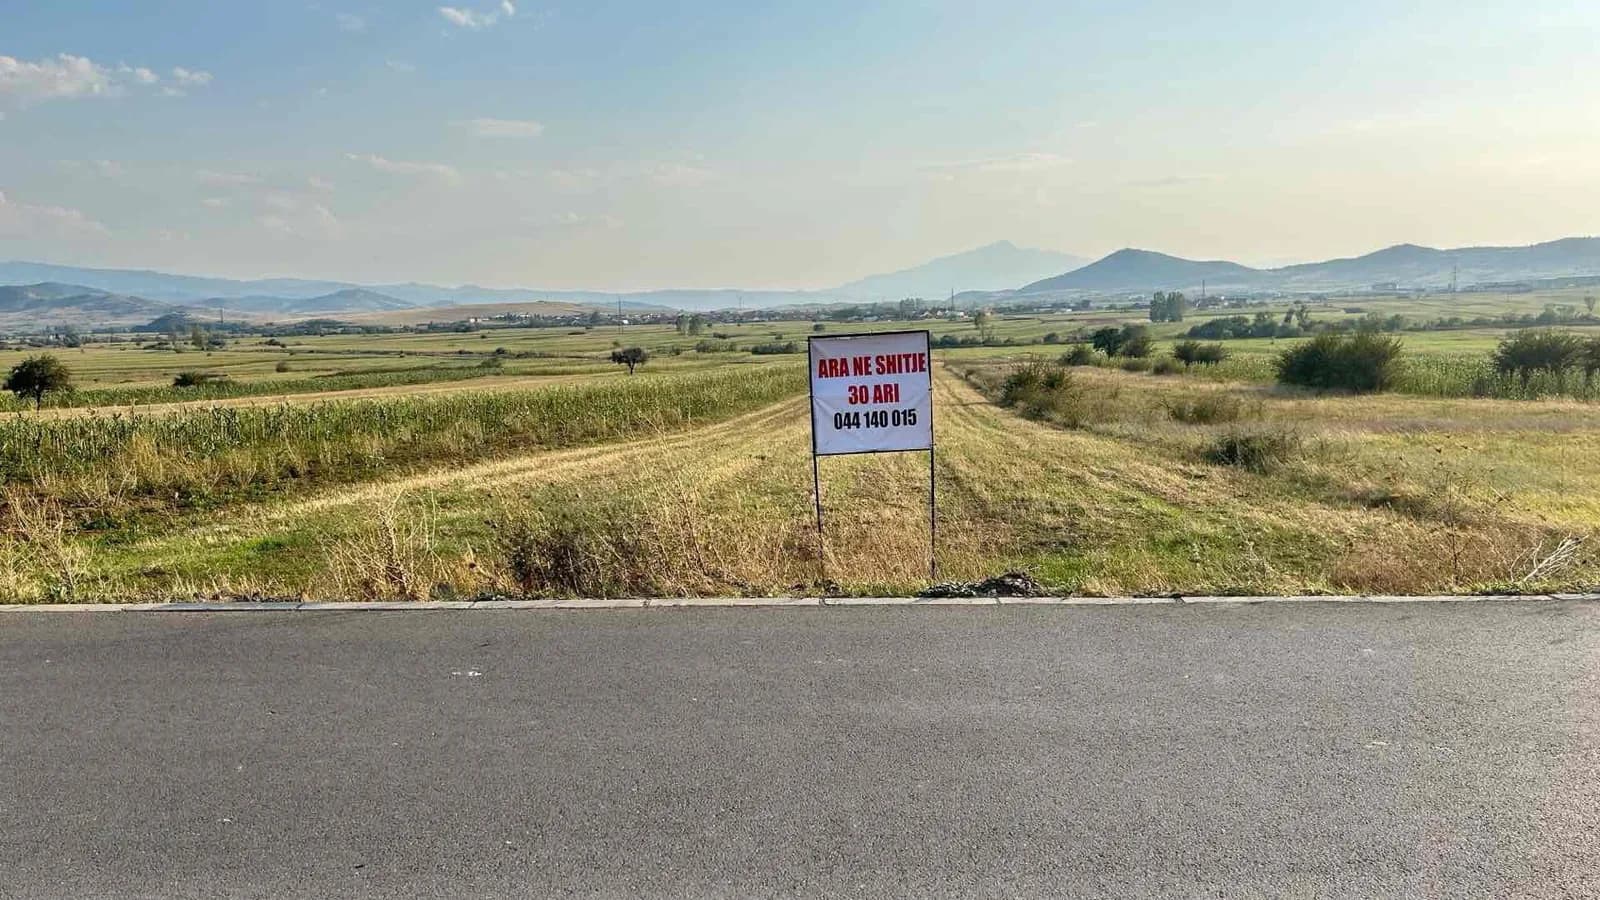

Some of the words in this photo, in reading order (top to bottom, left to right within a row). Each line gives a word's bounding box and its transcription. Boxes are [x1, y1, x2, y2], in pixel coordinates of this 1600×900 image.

[818, 358, 850, 378] ARA
[853, 356, 872, 376] NE
[875, 353, 926, 375] SHITJE
[848, 385, 868, 405] 30
[873, 383, 900, 404] ARI
[834, 412, 860, 430] 044
[864, 410, 888, 428] 140
[892, 408, 917, 427] 015
